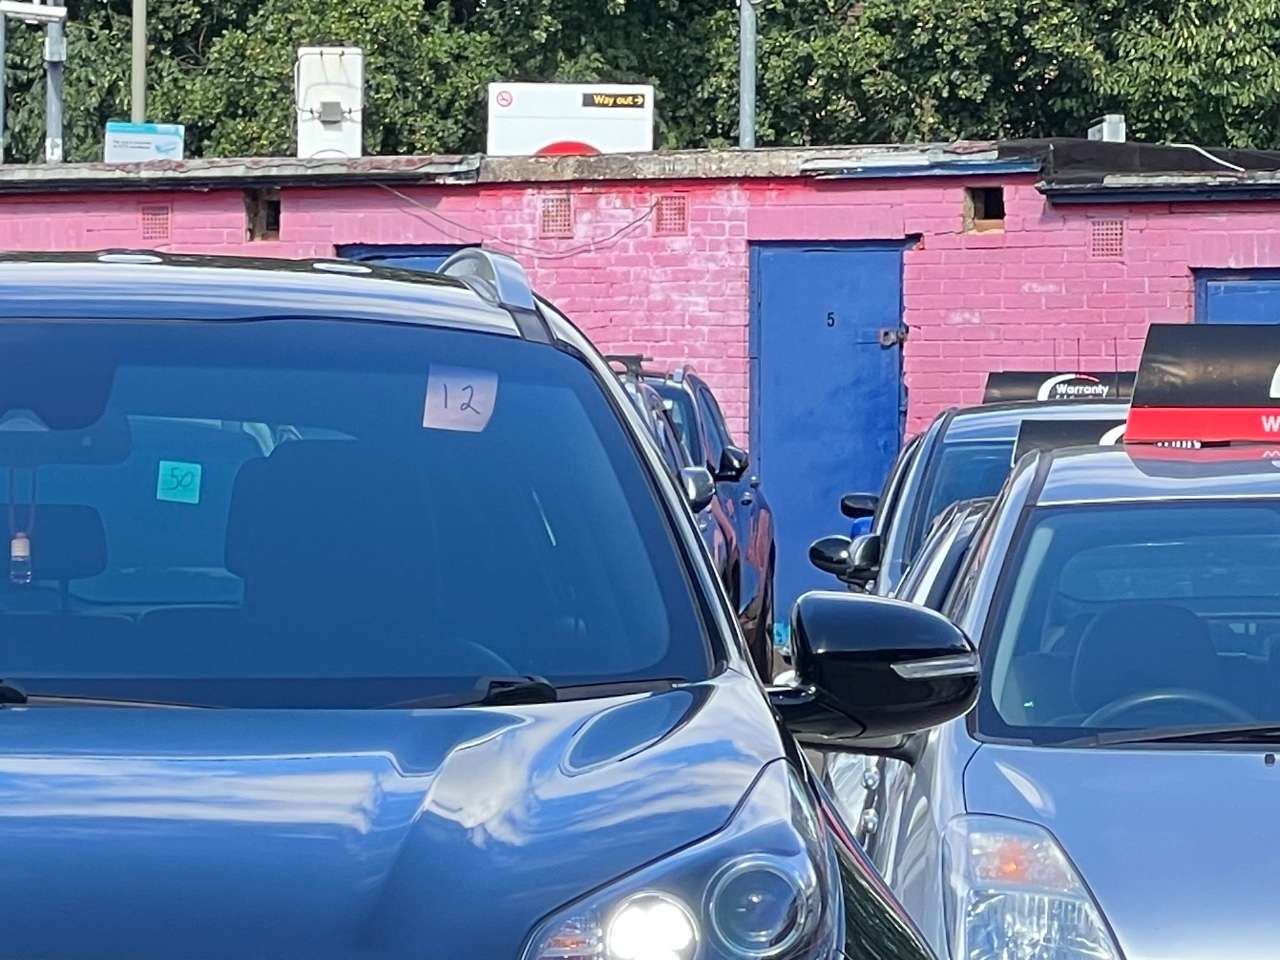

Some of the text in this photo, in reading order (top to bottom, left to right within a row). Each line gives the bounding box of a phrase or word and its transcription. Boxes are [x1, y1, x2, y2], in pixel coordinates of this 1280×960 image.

[593, 95, 634, 106] Way out
[826, 312, 835, 327] 5
[1055, 384, 1109, 397] Warranty
[443, 383, 481, 415] 12
